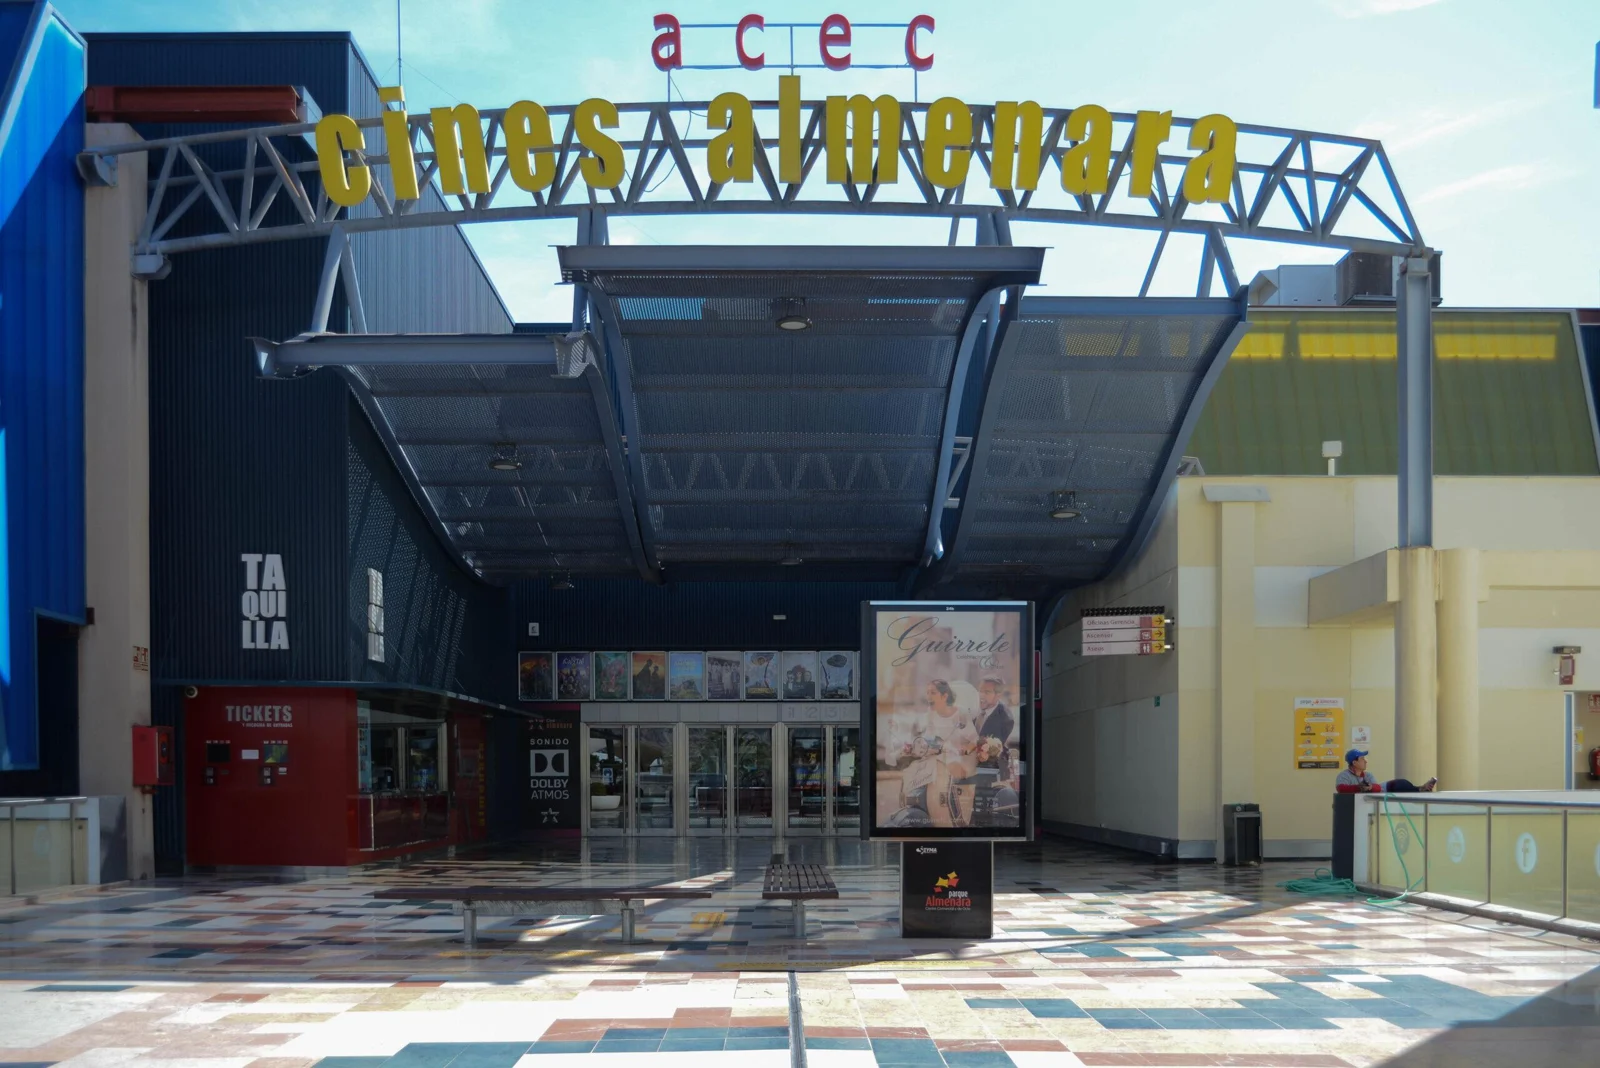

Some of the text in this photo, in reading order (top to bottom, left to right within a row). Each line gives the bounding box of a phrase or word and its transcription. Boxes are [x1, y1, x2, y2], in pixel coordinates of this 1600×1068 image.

[651, 14, 935, 71] acec
[315, 75, 1238, 207] cines almenara
[241, 553, 287, 591] TA
[241, 590, 287, 621] QUI
[242, 620, 290, 650] LLA
[225, 705, 292, 722] TICKETS
[530, 779, 569, 789] DOLBY
[530, 789, 570, 800] ATMOS
[926, 896, 971, 906] Almenara
[949, 890, 968, 899] parque
